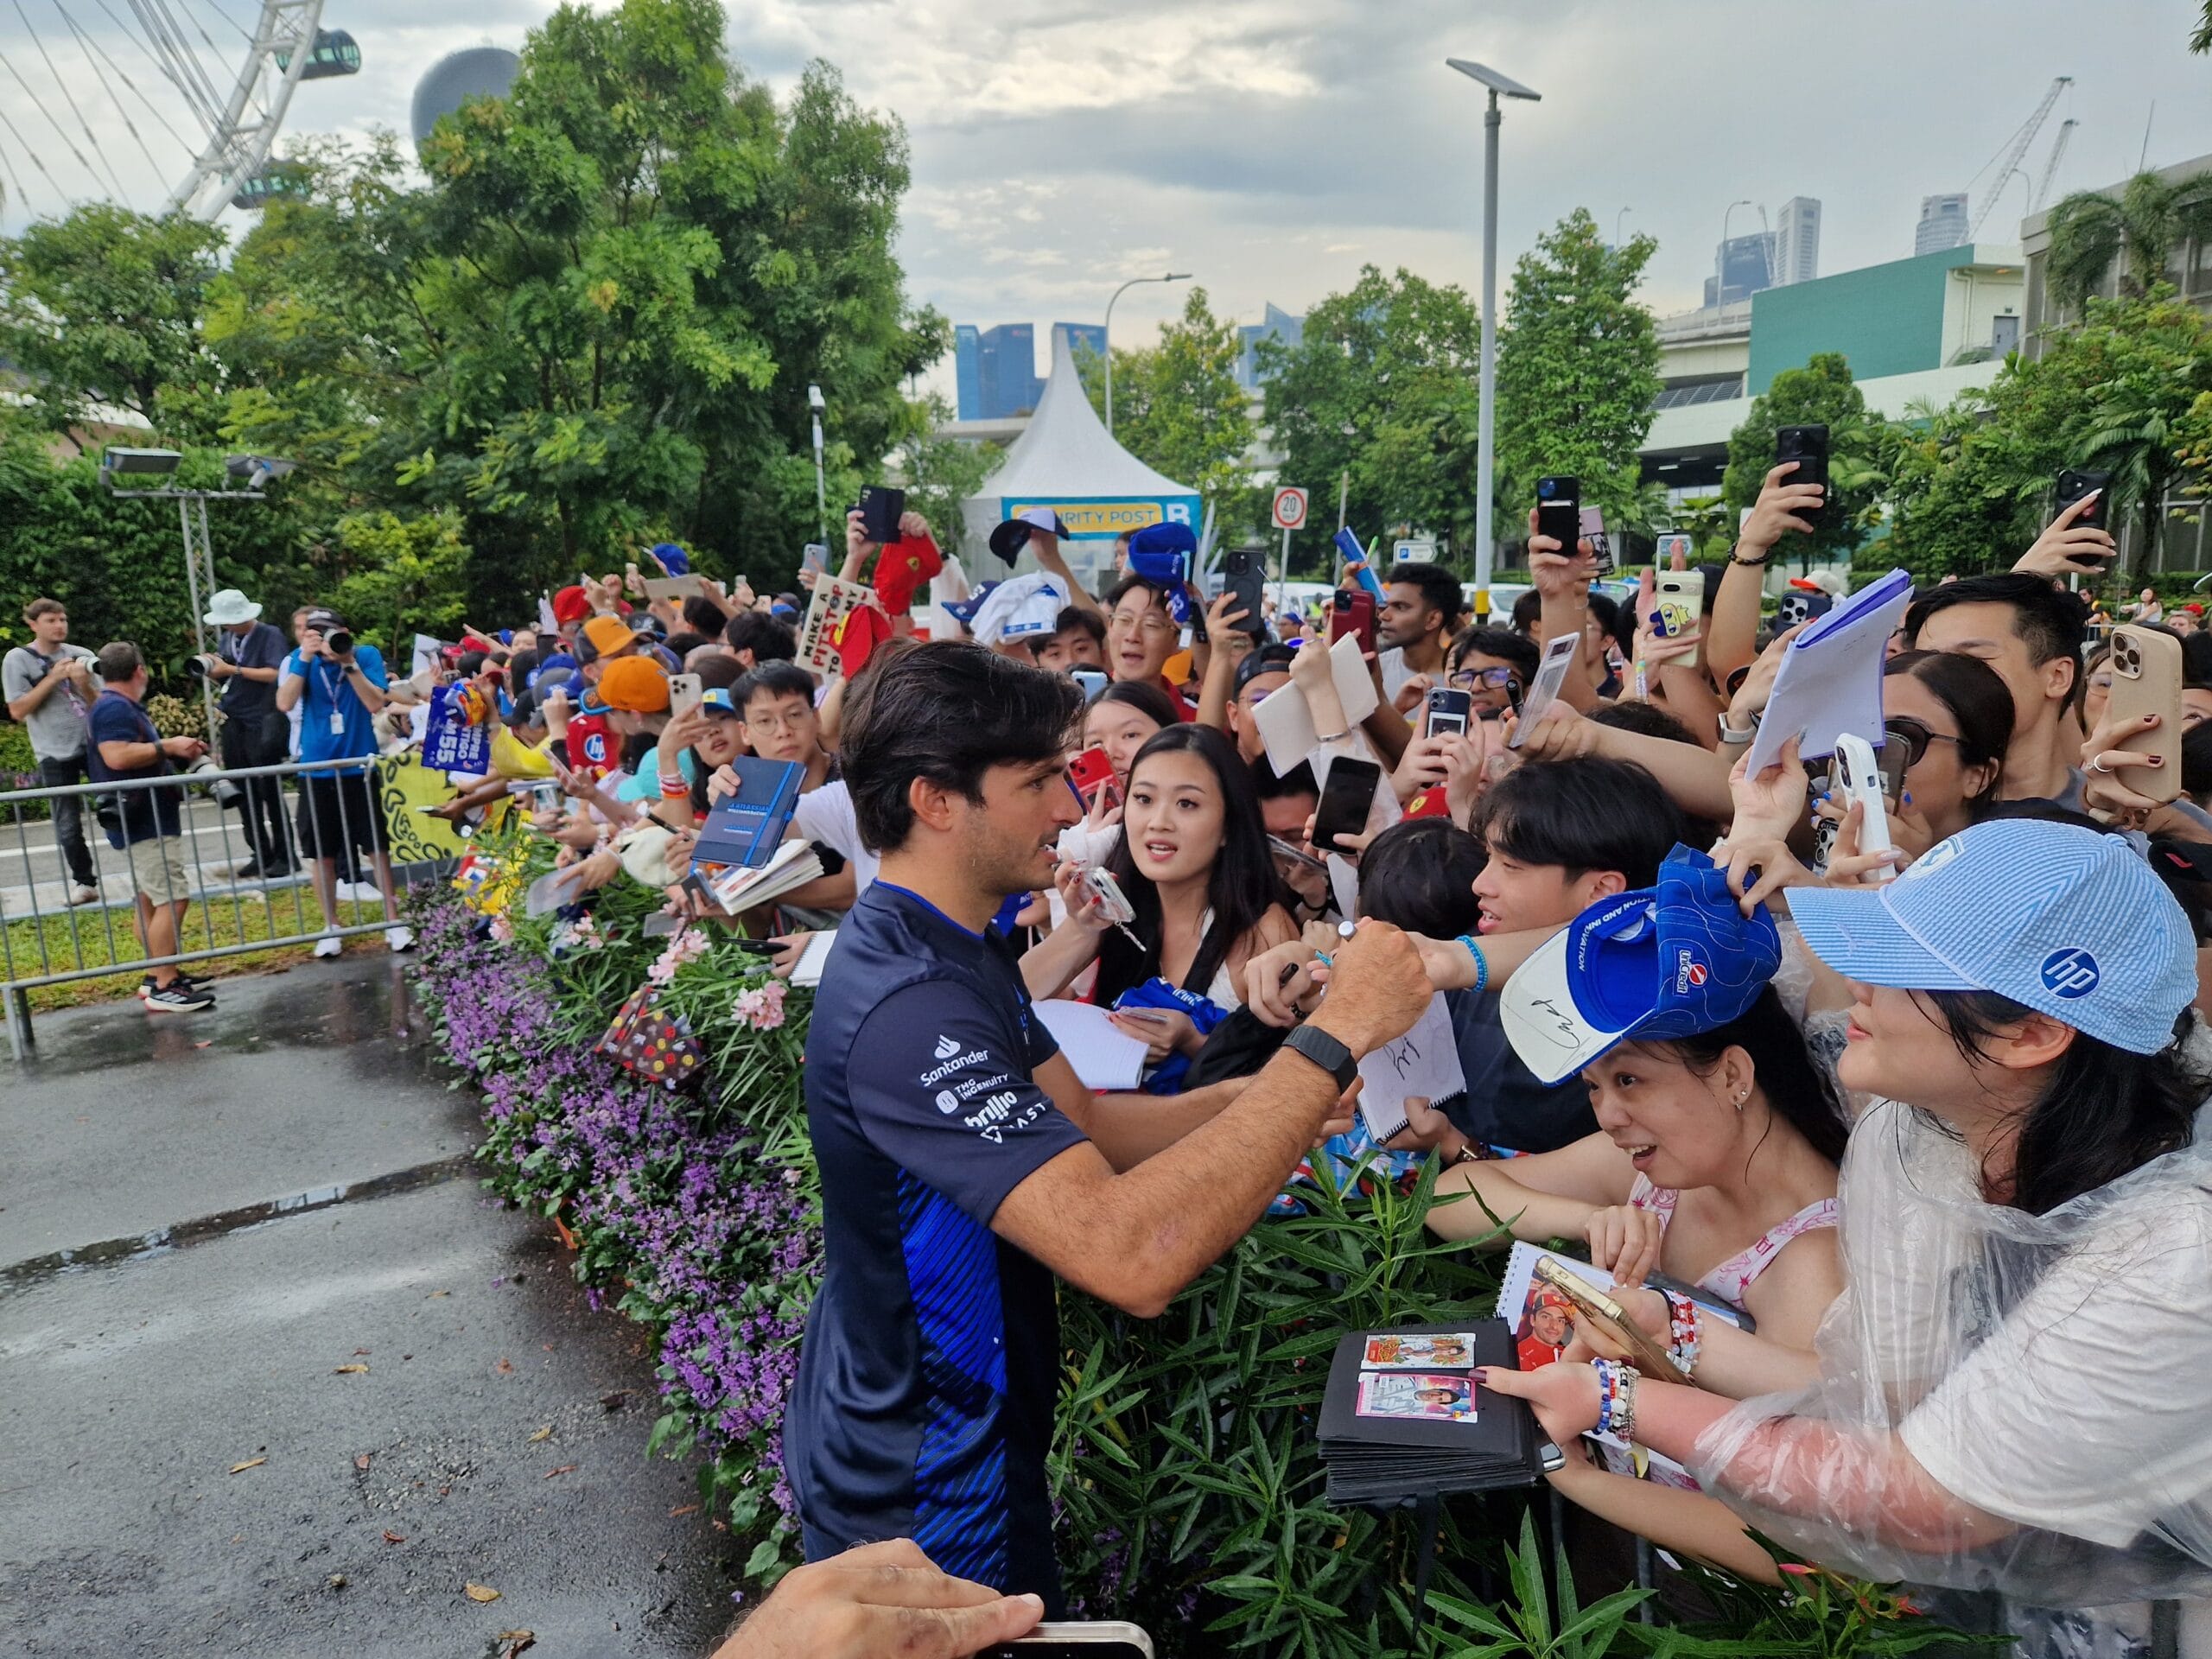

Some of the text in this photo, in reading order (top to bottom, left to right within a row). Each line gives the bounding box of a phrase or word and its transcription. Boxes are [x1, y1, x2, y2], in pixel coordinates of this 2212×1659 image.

[1109, 510, 1154, 524] POST
[1166, 503, 1191, 526] B
[1283, 496, 1296, 512] 20
[845, 589, 858, 612] MY
[804, 593, 829, 658] MAKE A
[828, 656, 840, 675] TO
[435, 734, 459, 764] 55
[1676, 949, 1692, 995] UniCredit
[2044, 949, 2097, 996] hp
[920, 1050, 988, 1087] Santander
[954, 1077, 976, 1094] THG
[963, 1090, 1018, 1128] brillio
